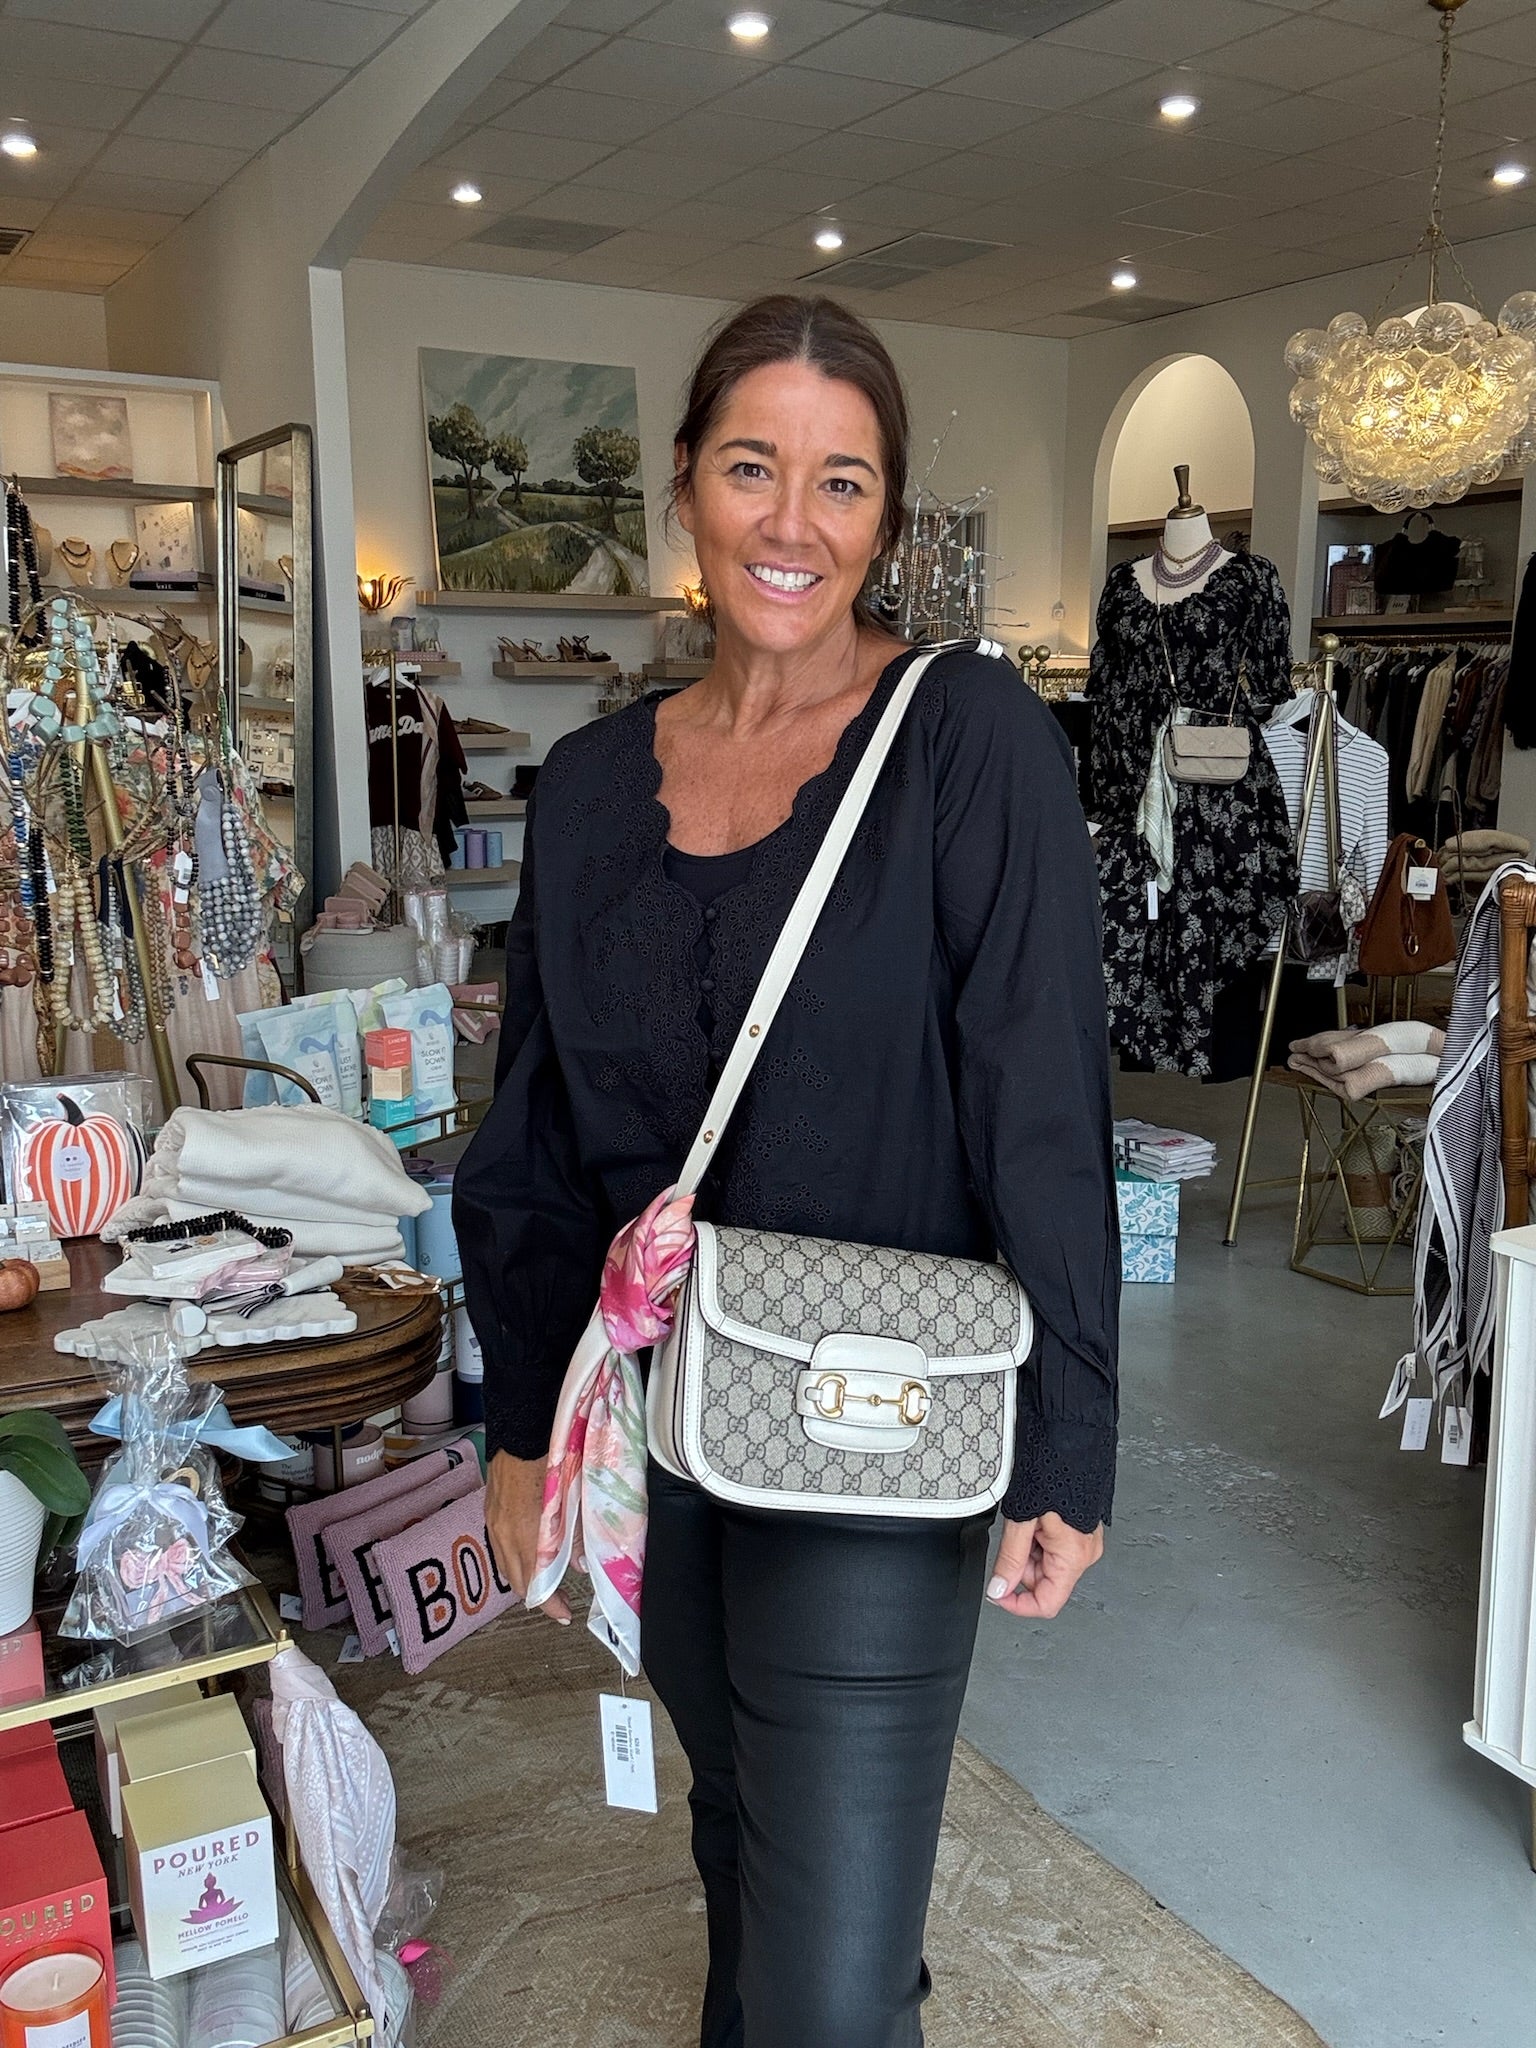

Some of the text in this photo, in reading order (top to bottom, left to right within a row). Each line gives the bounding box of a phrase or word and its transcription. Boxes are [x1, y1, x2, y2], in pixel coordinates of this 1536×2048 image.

[397, 715, 424, 737] Da
[153, 1830, 260, 1875] POURED
[177, 1854, 240, 1879] NEW YORK
[177, 1923, 213, 1940] MELLOW
[215, 1912, 249, 1928] POMELO
